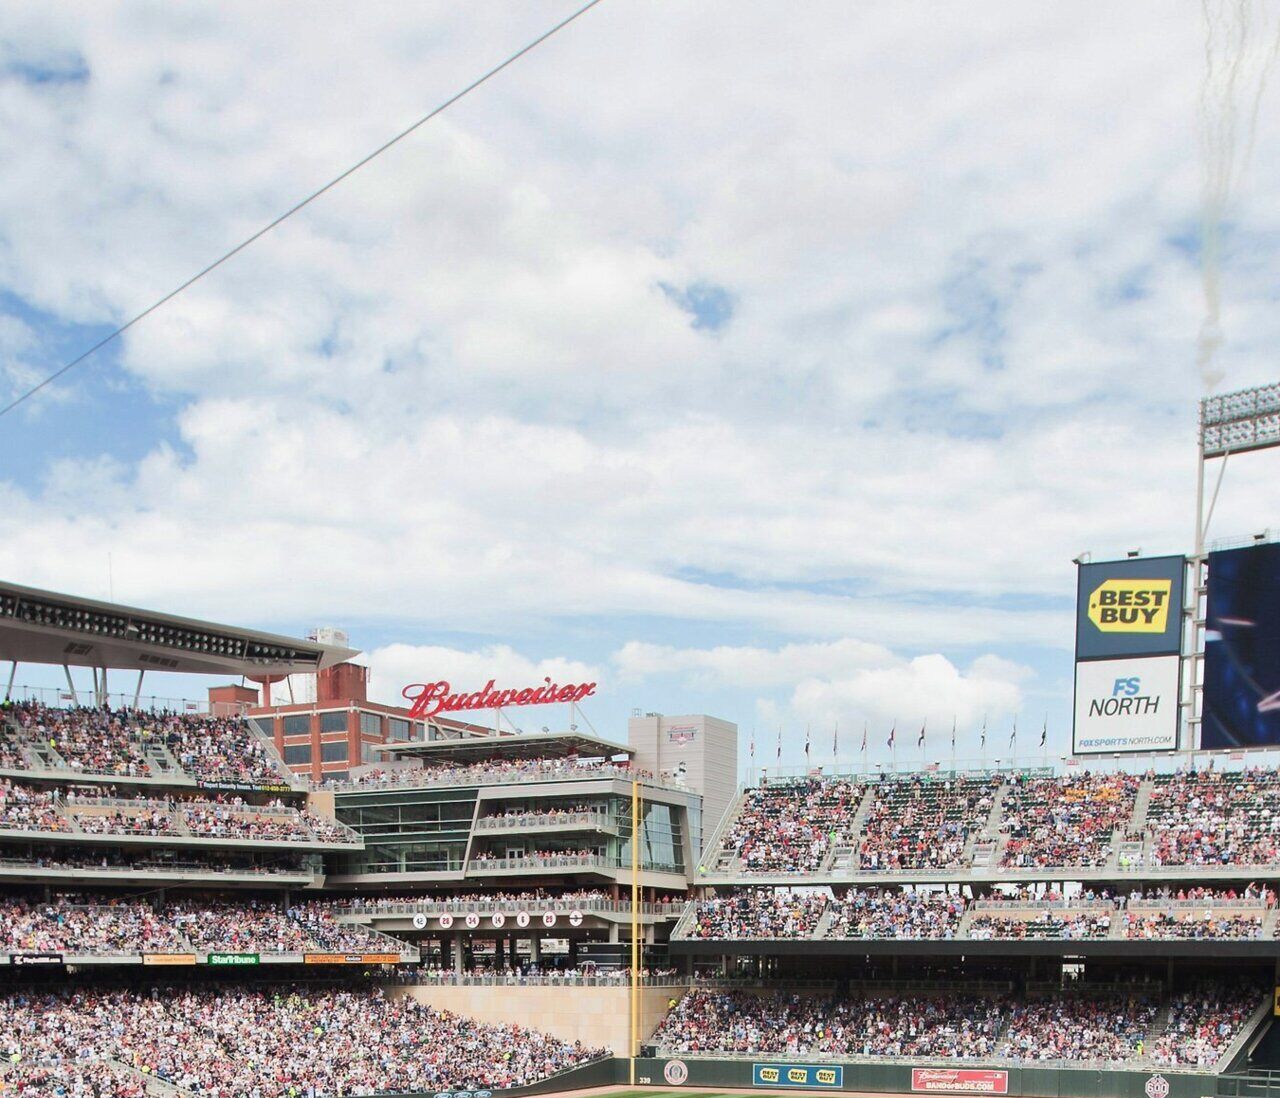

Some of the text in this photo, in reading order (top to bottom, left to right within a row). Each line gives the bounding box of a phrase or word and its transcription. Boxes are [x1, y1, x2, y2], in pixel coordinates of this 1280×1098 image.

[1098, 590, 1167, 606] BEST
[1100, 607, 1160, 624] BUY
[1112, 676, 1141, 697] FS
[401, 676, 597, 719] Budweiser
[1088, 695, 1160, 718] NORTH
[212, 955, 256, 964] StarTribune
[1147, 1083, 1167, 1092] 600
